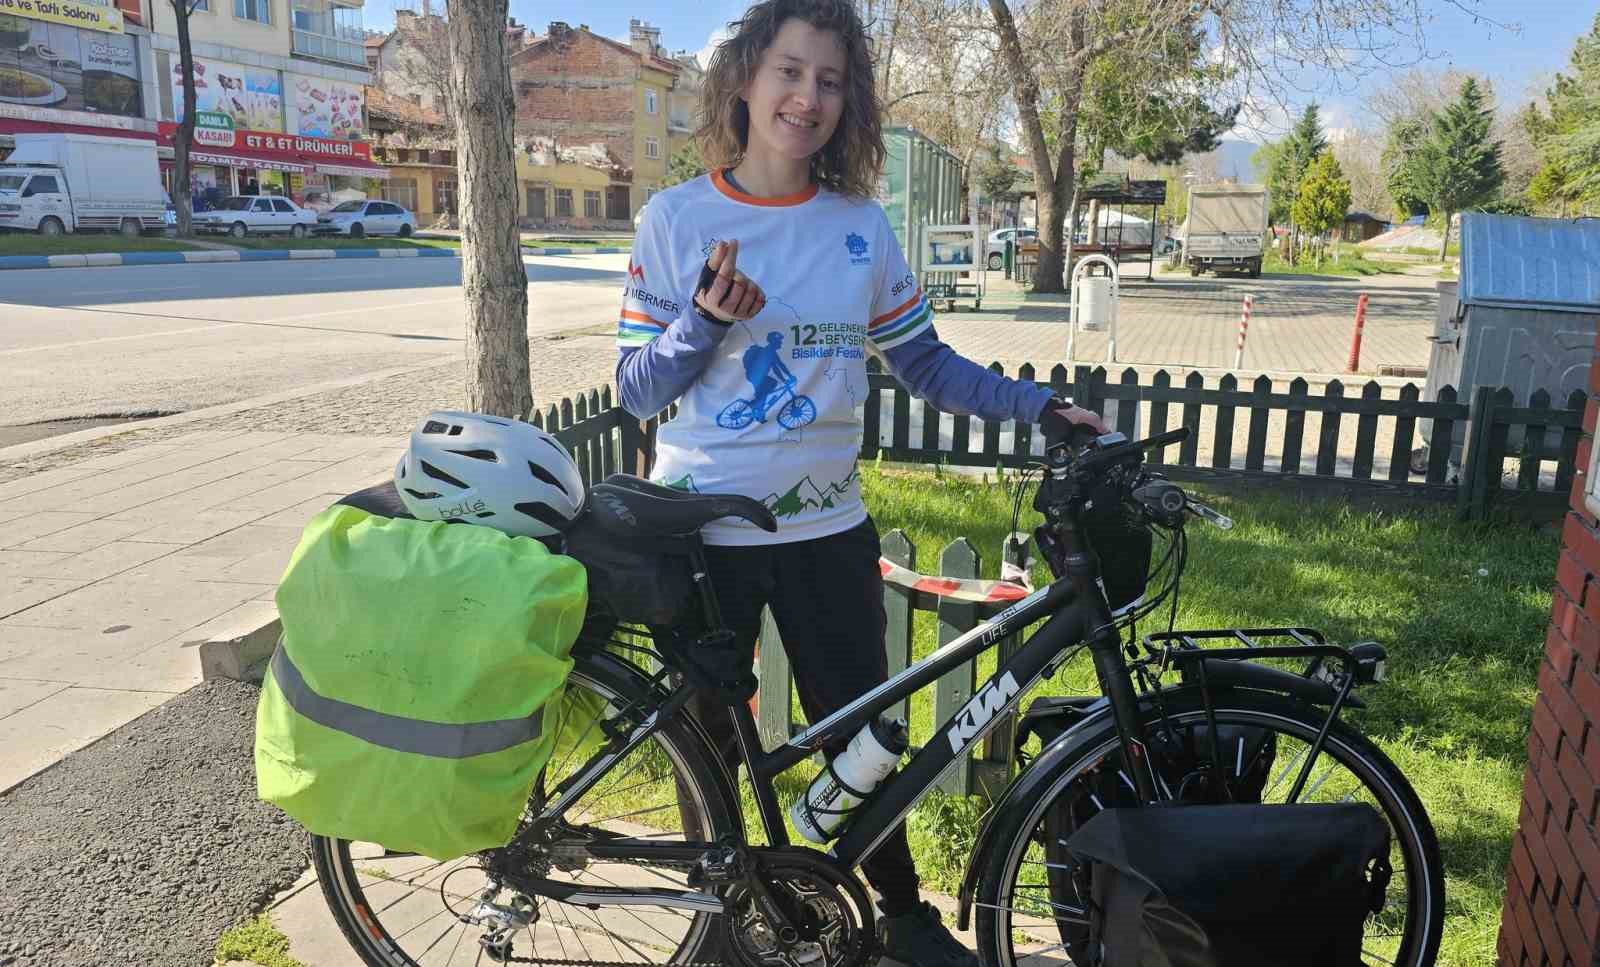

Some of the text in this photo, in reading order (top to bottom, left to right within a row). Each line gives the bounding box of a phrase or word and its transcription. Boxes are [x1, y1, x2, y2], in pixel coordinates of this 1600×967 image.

[17, 1, 32, 10] ve
[63, 5, 100, 22] Salonu
[199, 114, 229, 127] DAMLA
[246, 135, 260, 147] ET
[265, 136, 275, 149] &
[278, 138, 292, 150] ET
[295, 136, 353, 156] ÜRÜNLERİ
[631, 288, 680, 315] MERMER
[982, 621, 1008, 646] LIFE
[947, 670, 1021, 755] KTM
